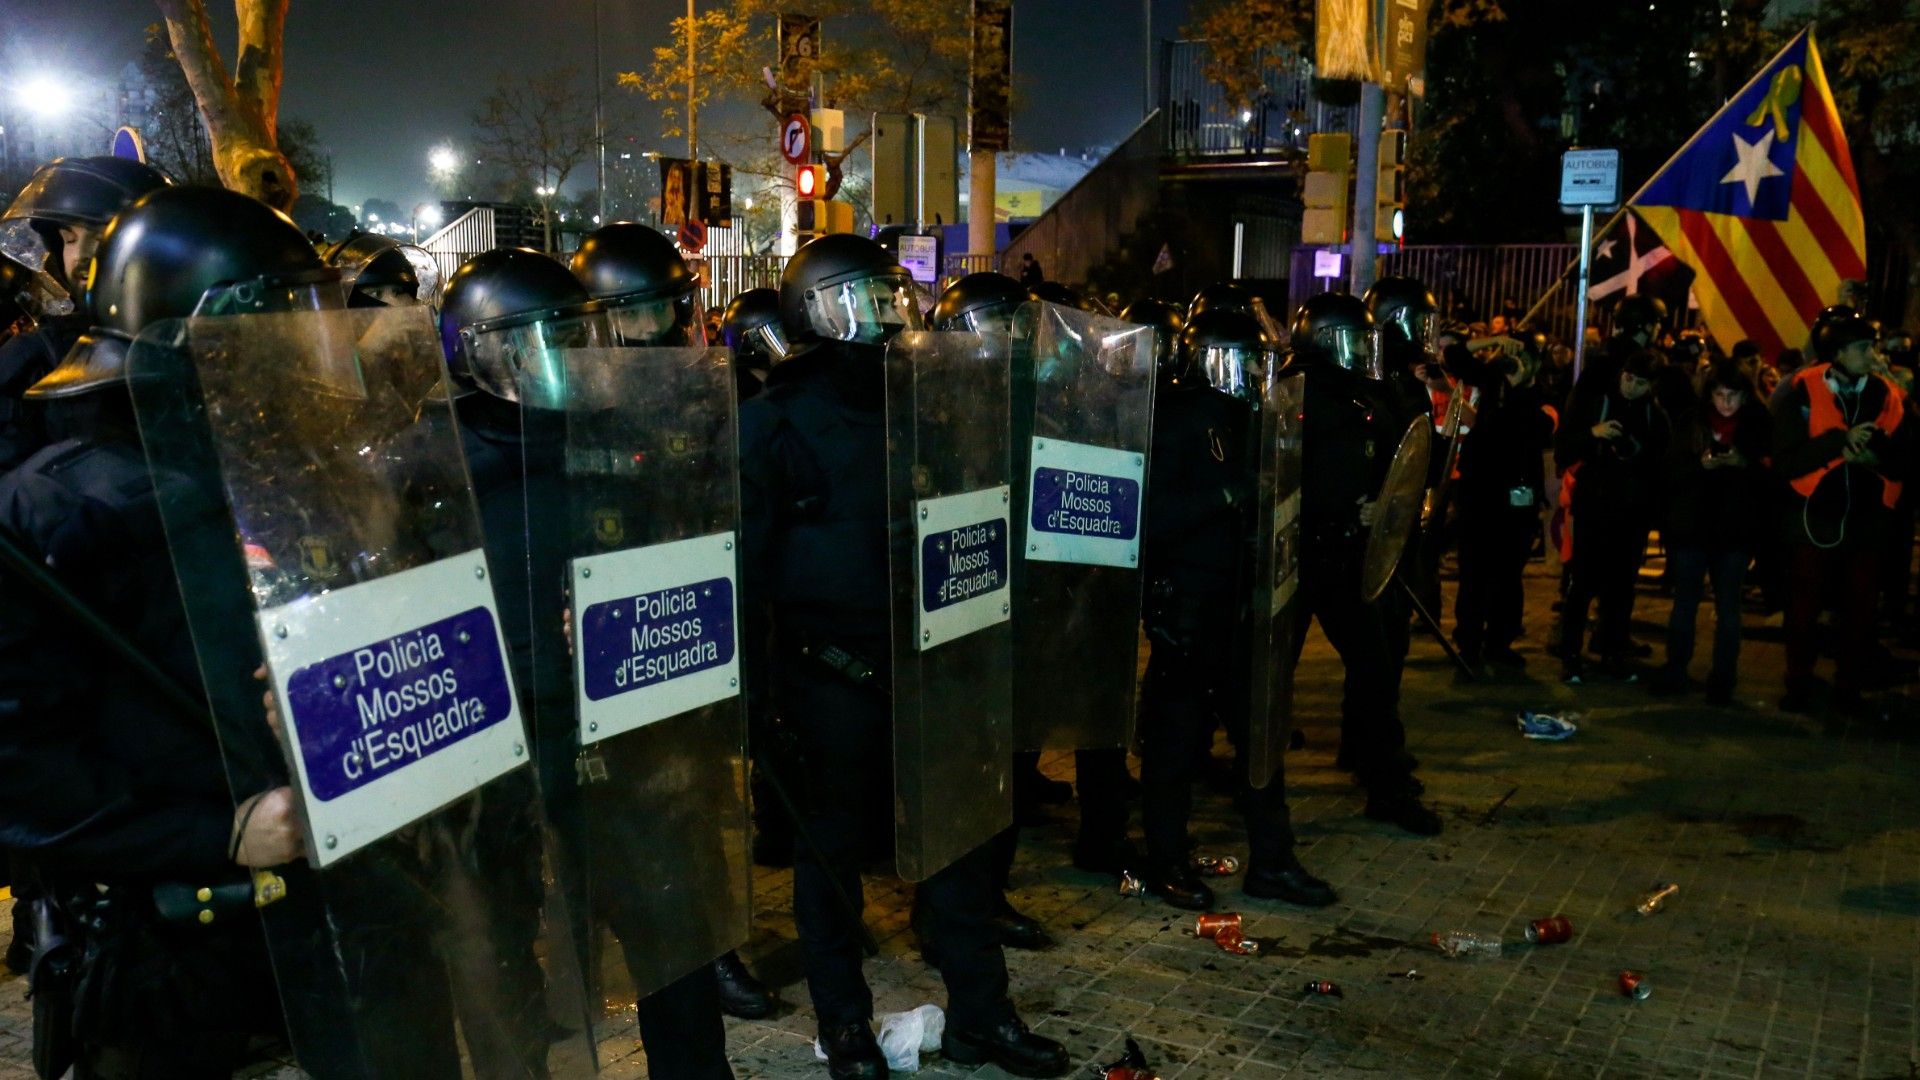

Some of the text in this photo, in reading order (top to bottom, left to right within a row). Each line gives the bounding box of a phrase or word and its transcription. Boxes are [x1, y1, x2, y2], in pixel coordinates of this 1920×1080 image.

[1565, 160, 1617, 169] AUTOBUS
[1066, 472, 1109, 494] Policia
[1061, 491, 1111, 514] Mossos
[951, 525, 987, 550] Policia
[1047, 510, 1121, 535] d'Esquadra
[949, 549, 990, 575] Mossos
[940, 569, 998, 602] d'Esquadra
[635, 588, 697, 623] Policia
[631, 617, 702, 654] Mossos
[354, 631, 445, 687] Policia
[615, 640, 718, 687] d'Esquadra
[356, 667, 458, 730] Mossos
[342, 696, 486, 779] d'Esquadra
